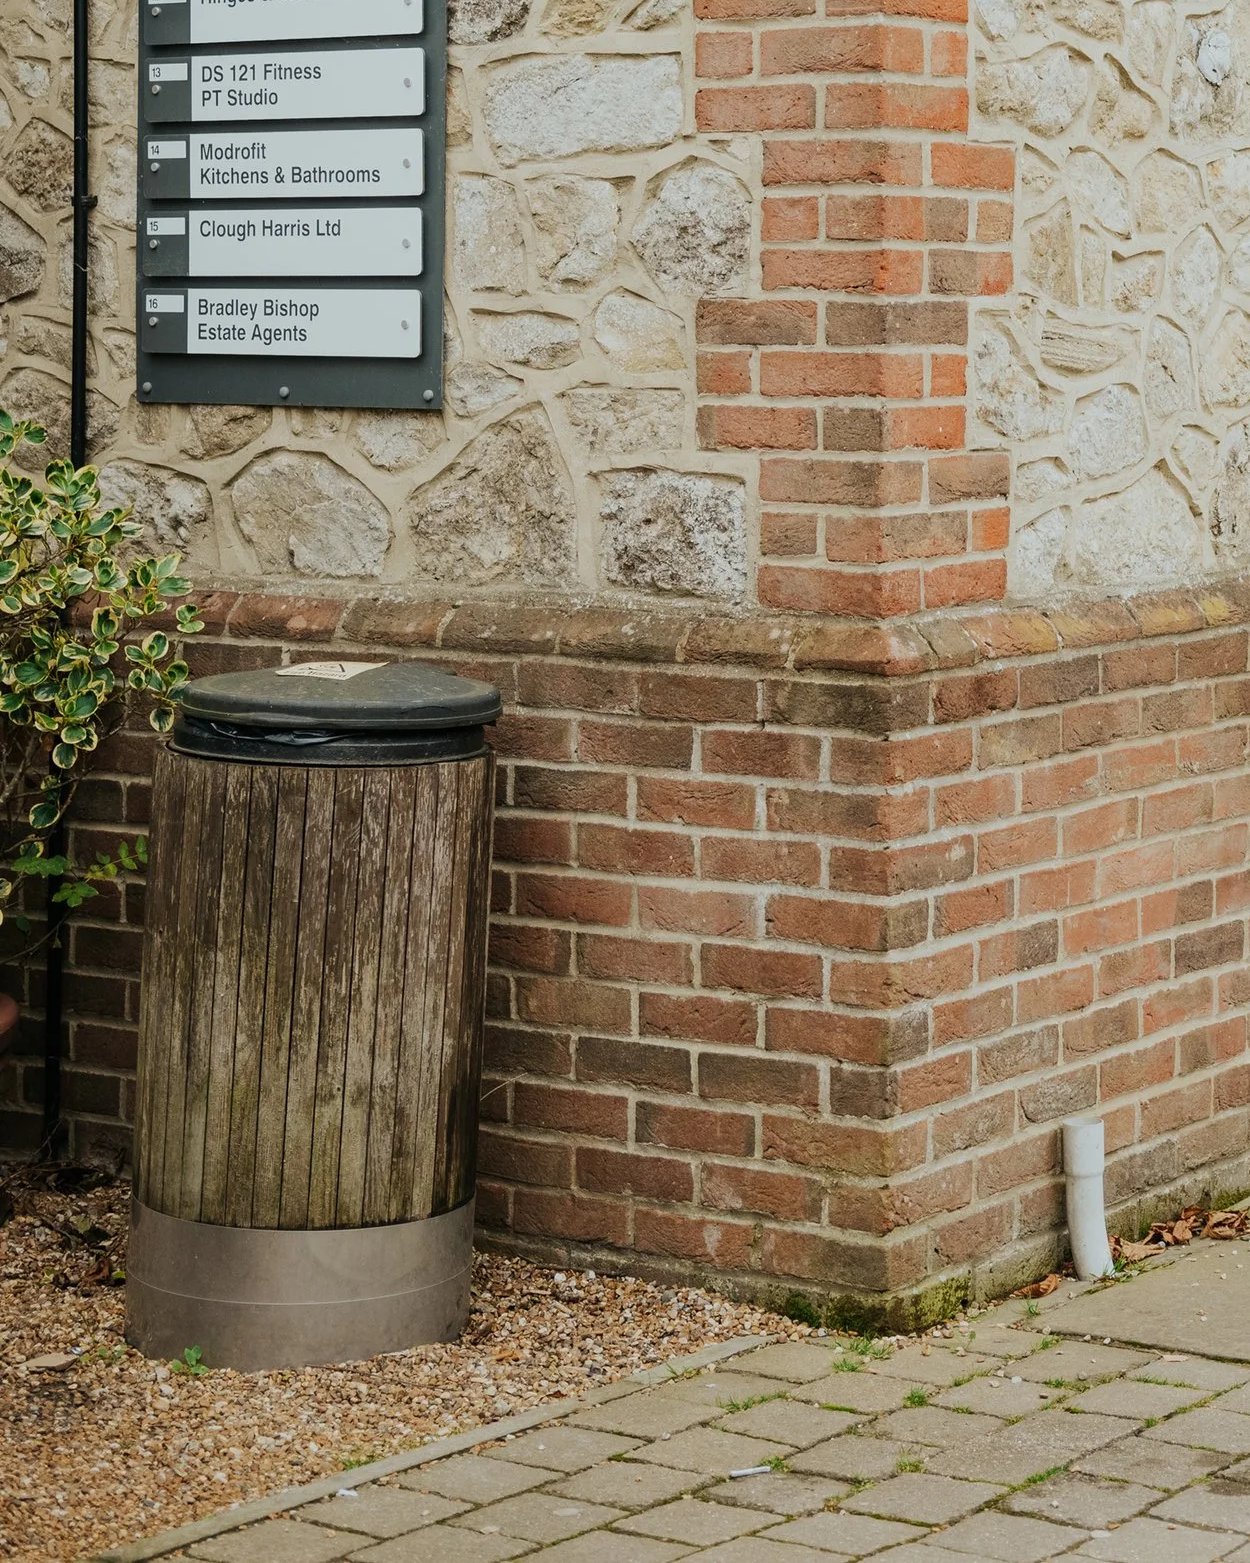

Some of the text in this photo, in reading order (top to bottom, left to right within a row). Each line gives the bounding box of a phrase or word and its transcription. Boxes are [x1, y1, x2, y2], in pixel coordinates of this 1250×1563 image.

[151, 67, 162, 78] 13
[201, 63, 321, 82] DS 121 Fitness
[201, 87, 278, 106] PT Studio
[151, 145, 160, 155] 14
[200, 141, 266, 160] Modrofit
[200, 166, 380, 185] Kitchens & Bathrooms
[150, 221, 159, 231] 15
[200, 218, 341, 240] Clough Harris Ltd
[149, 298, 158, 309] 16
[198, 299, 319, 321] Bradley Bishop
[198, 323, 307, 345] Estate Agents
